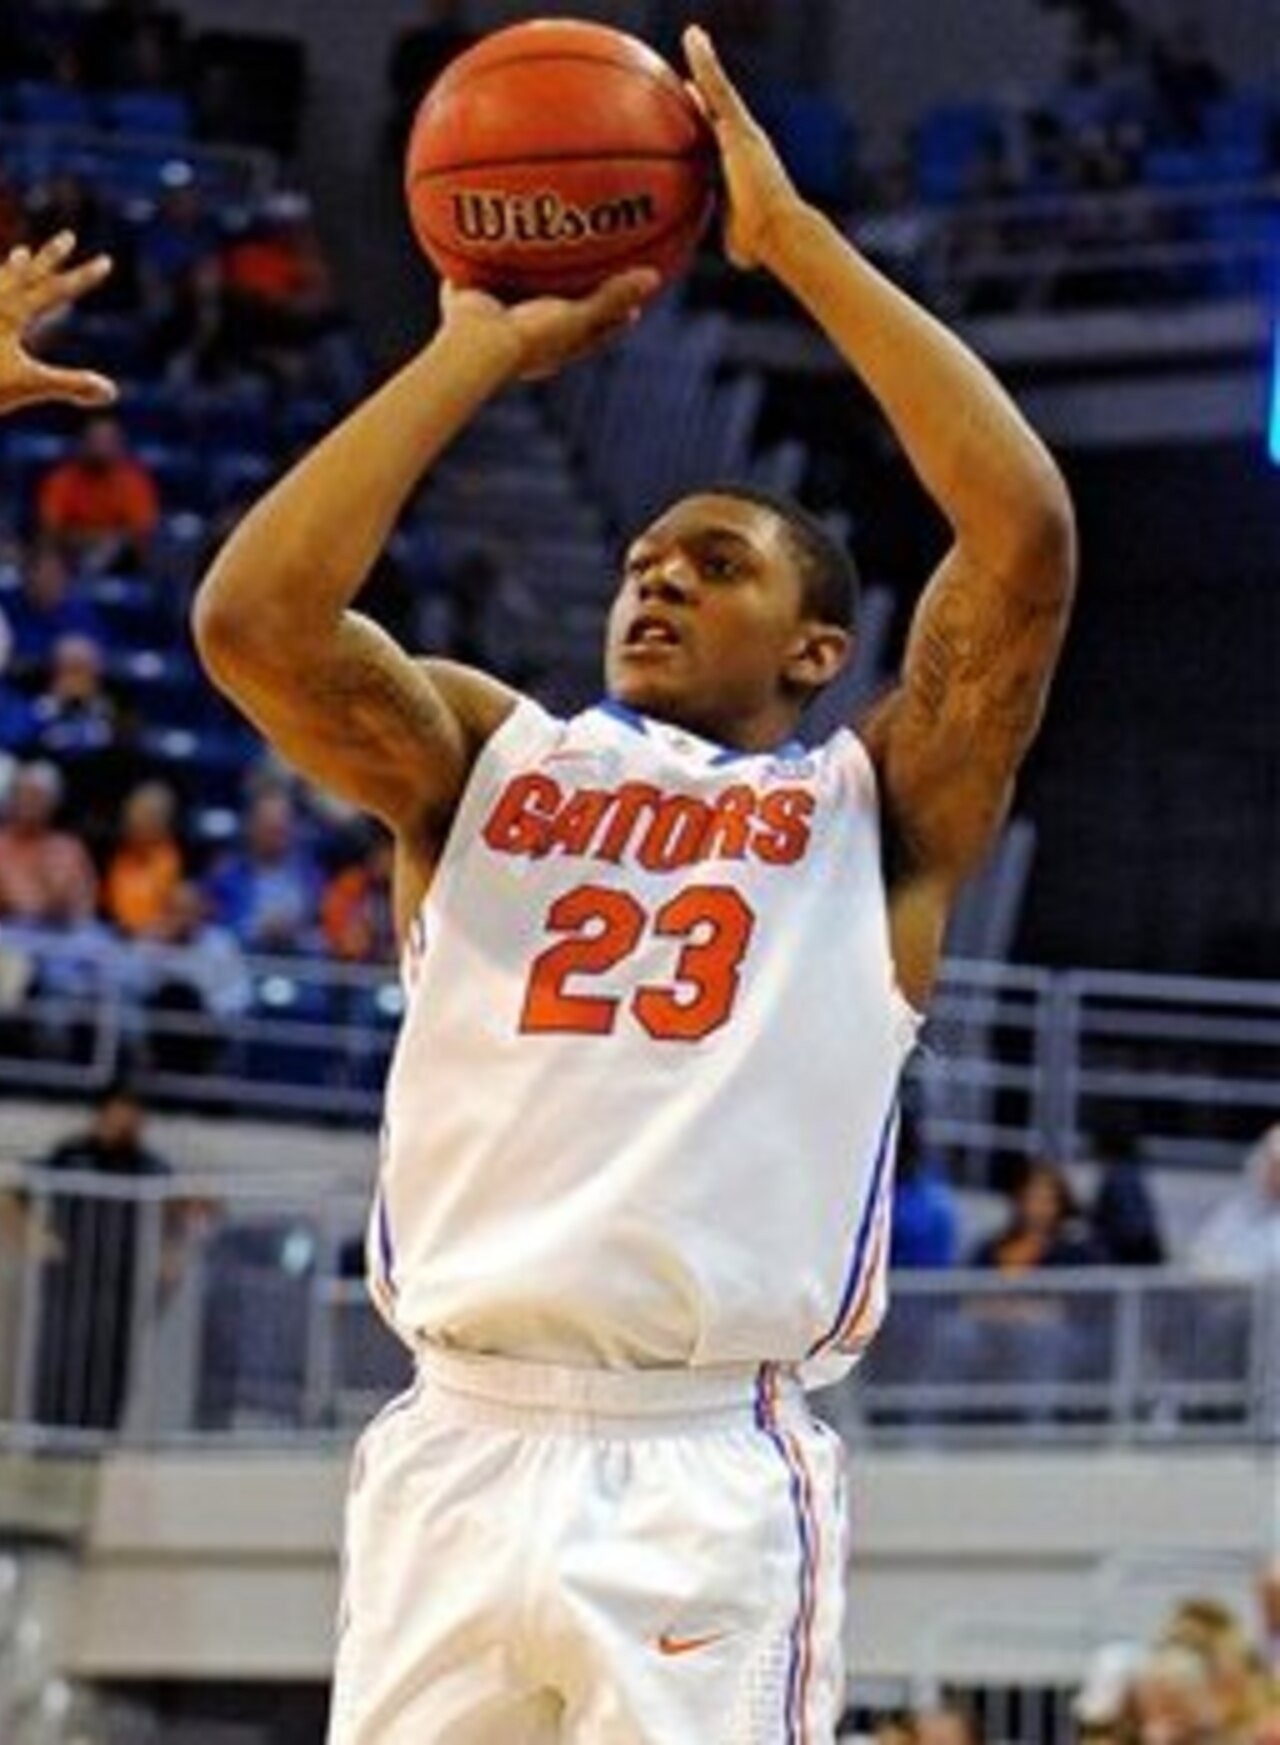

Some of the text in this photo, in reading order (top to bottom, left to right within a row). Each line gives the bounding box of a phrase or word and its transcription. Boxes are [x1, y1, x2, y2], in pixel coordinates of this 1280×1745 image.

[453, 192, 654, 244] Wilson
[483, 773, 816, 872] GATORS
[520, 885, 755, 1041] 23
